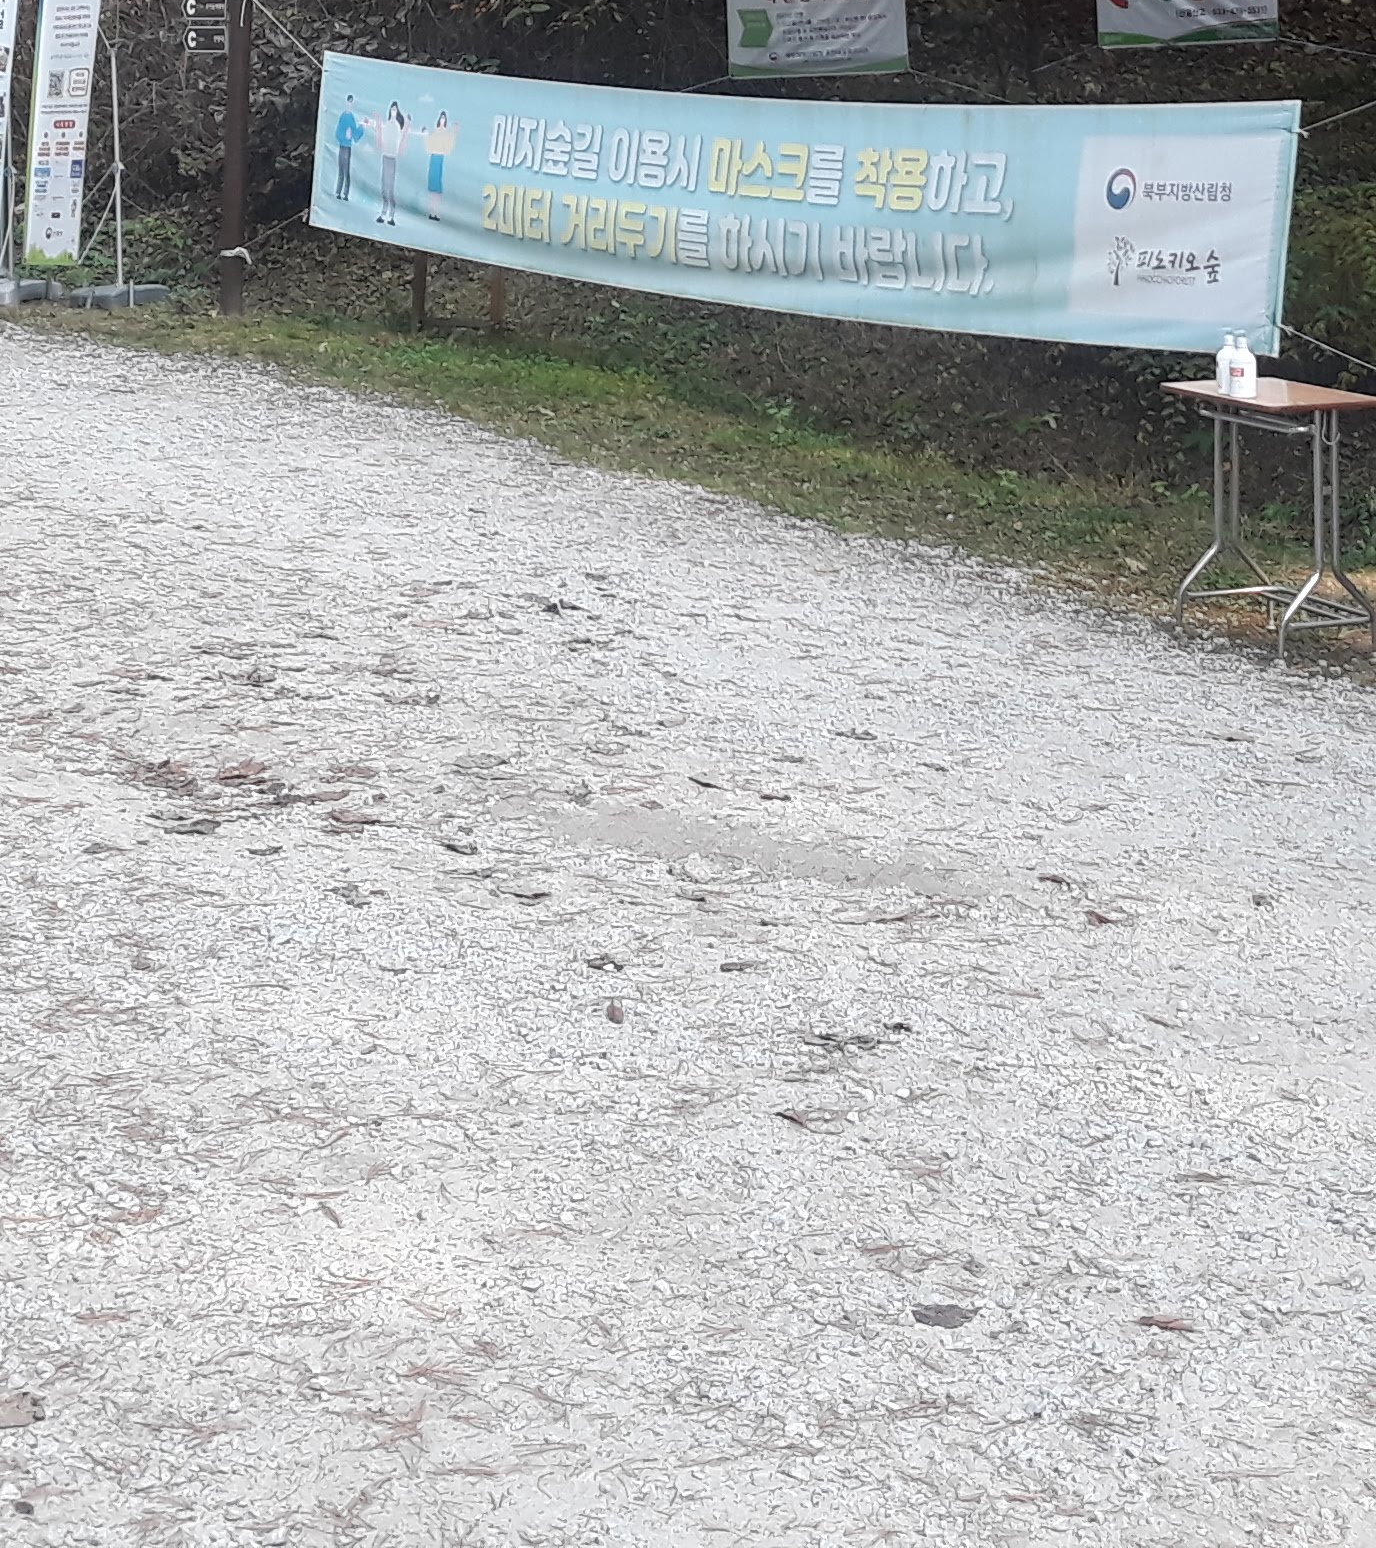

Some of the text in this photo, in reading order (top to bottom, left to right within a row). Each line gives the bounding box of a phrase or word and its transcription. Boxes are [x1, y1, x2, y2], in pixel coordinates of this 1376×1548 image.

[489, 115, 1014, 221] 매지숲길 이용시 마스크를 착용하고,
[1142, 182, 1232, 202] 북부지방산림청
[482, 184, 994, 296] 2미터 거리두기를 하시기 바랍니다.
[1137, 249, 1220, 284] 피노키오 숲
